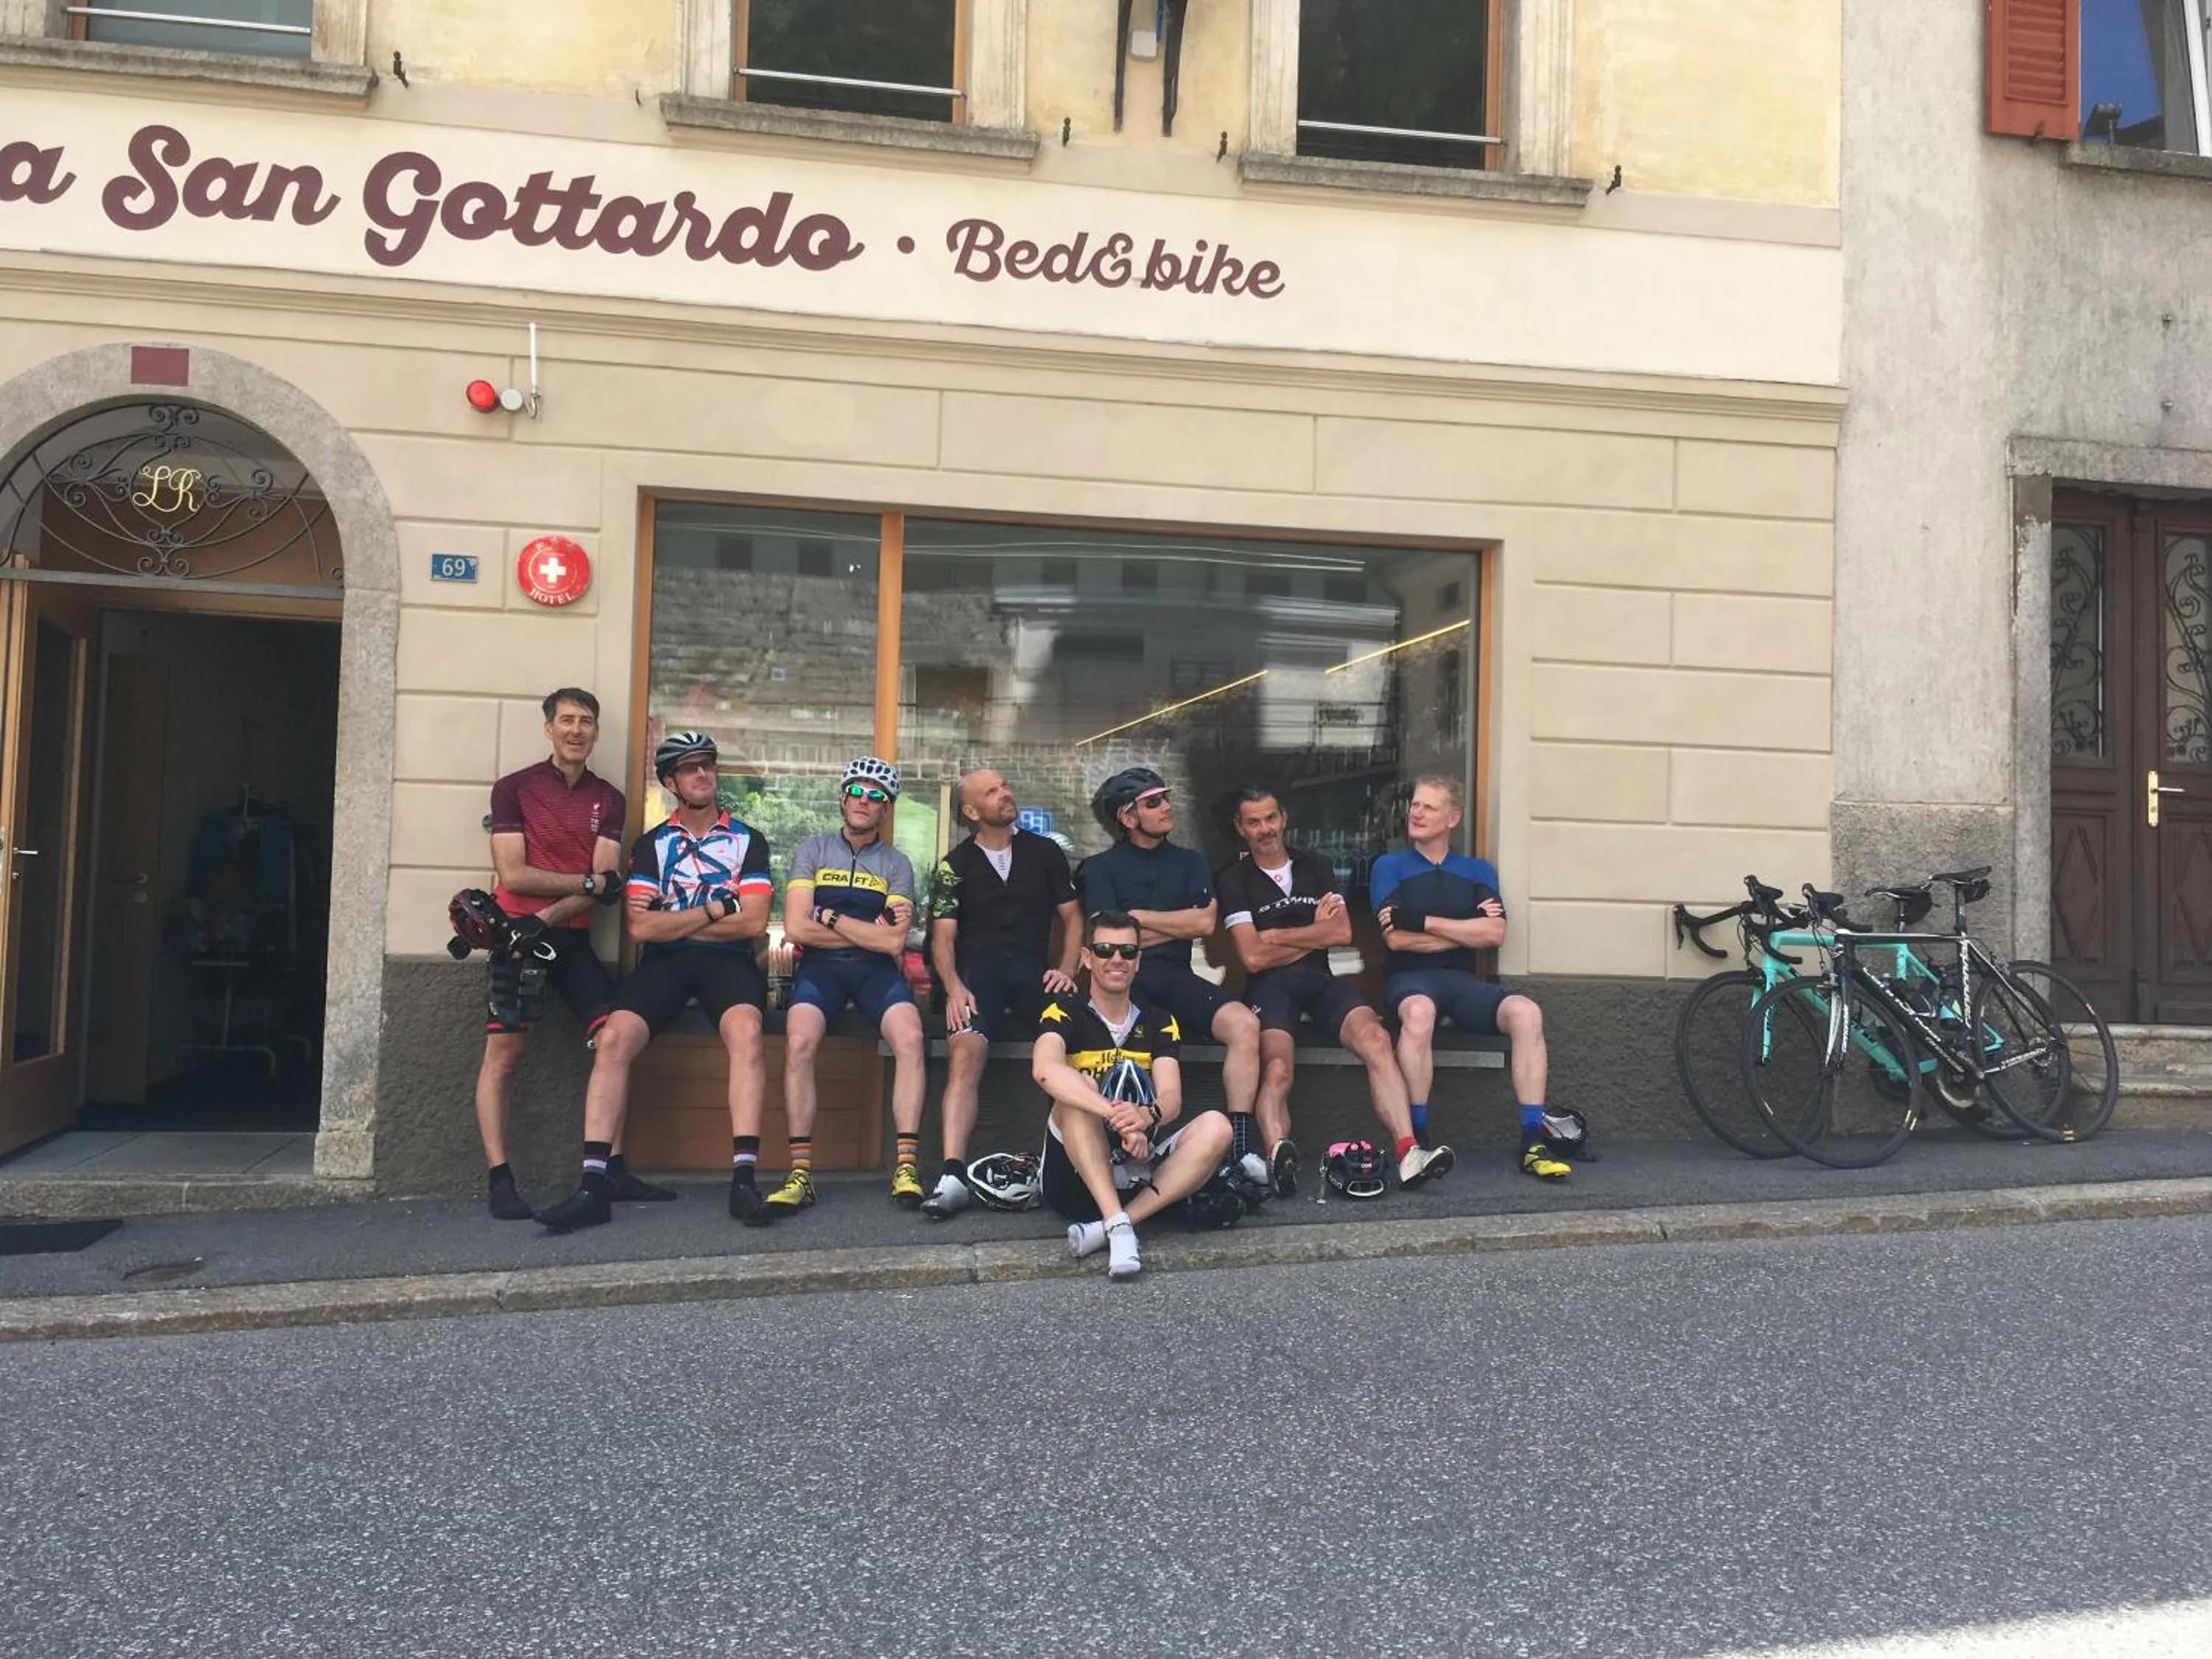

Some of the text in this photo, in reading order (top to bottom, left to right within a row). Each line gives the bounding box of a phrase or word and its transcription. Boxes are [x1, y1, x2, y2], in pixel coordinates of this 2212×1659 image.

[102, 125, 341, 231] San
[362, 150, 865, 271] Gottardo
[442, 557, 465, 577] 69
[529, 587, 573, 605] HOTEL
[822, 872, 869, 885] CRAFT
